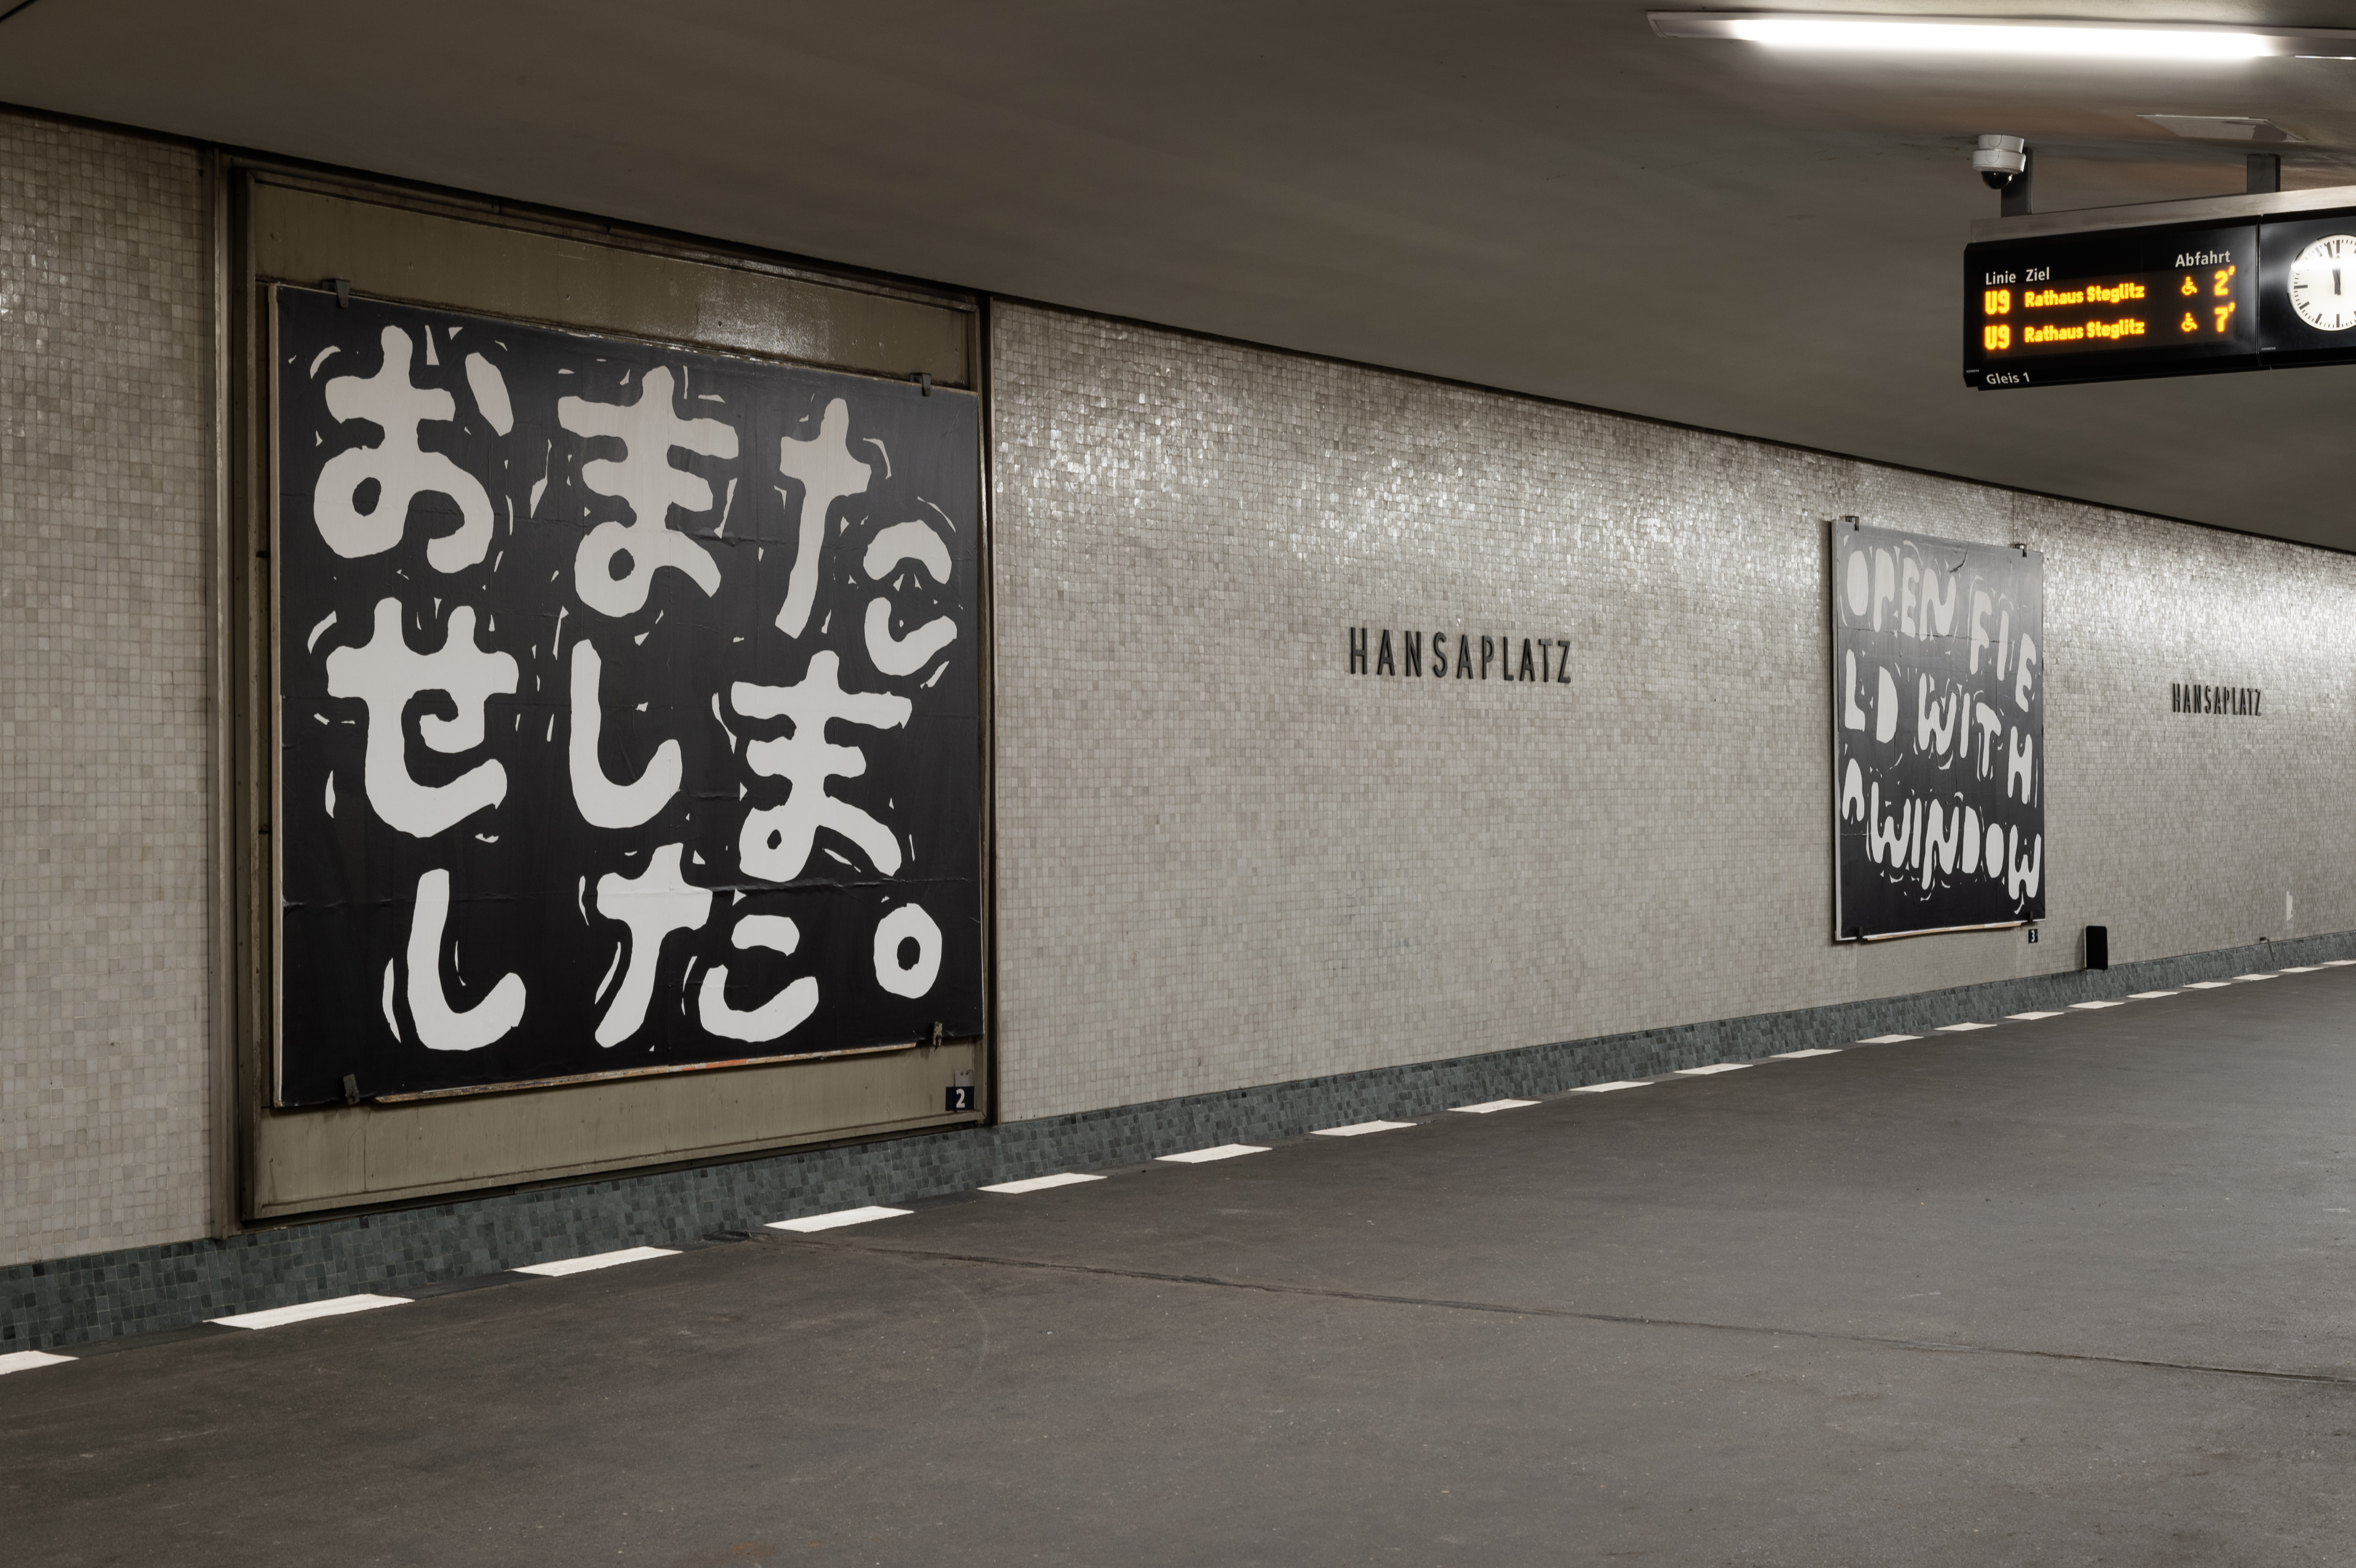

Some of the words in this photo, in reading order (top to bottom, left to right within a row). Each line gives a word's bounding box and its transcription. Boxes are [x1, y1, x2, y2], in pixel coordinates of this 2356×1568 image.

[1985, 270, 2016, 285] Linie
[2026, 266, 2049, 282] Ziel
[2175, 250, 2230, 267] Abfahrt
[1985, 289, 2010, 314] U9
[2025, 289, 2084, 308] Rathaus
[2087, 283, 2144, 303] Steglitz
[1985, 325, 2010, 350] U9
[2025, 325, 2084, 342] Rathaus
[2087, 318, 2144, 339] Steglitz
[1986, 372, 2020, 384] Gleis
[2023, 371, 2030, 382] 1
[1847, 548, 1957, 641] OPEN
[1970, 590, 2037, 713] FIE
[1350, 627, 1571, 683] HANSAPLATZ
[2172, 683, 2262, 716] HANSAPLATZ
[1844, 649, 1899, 744] LD
[1918, 673, 2033, 805] WITH
[1842, 758, 1865, 822] A
[1870, 781, 2041, 900] WINDOW
[2031, 930, 2035, 942] 3
[956, 1088, 965, 1108] 2
